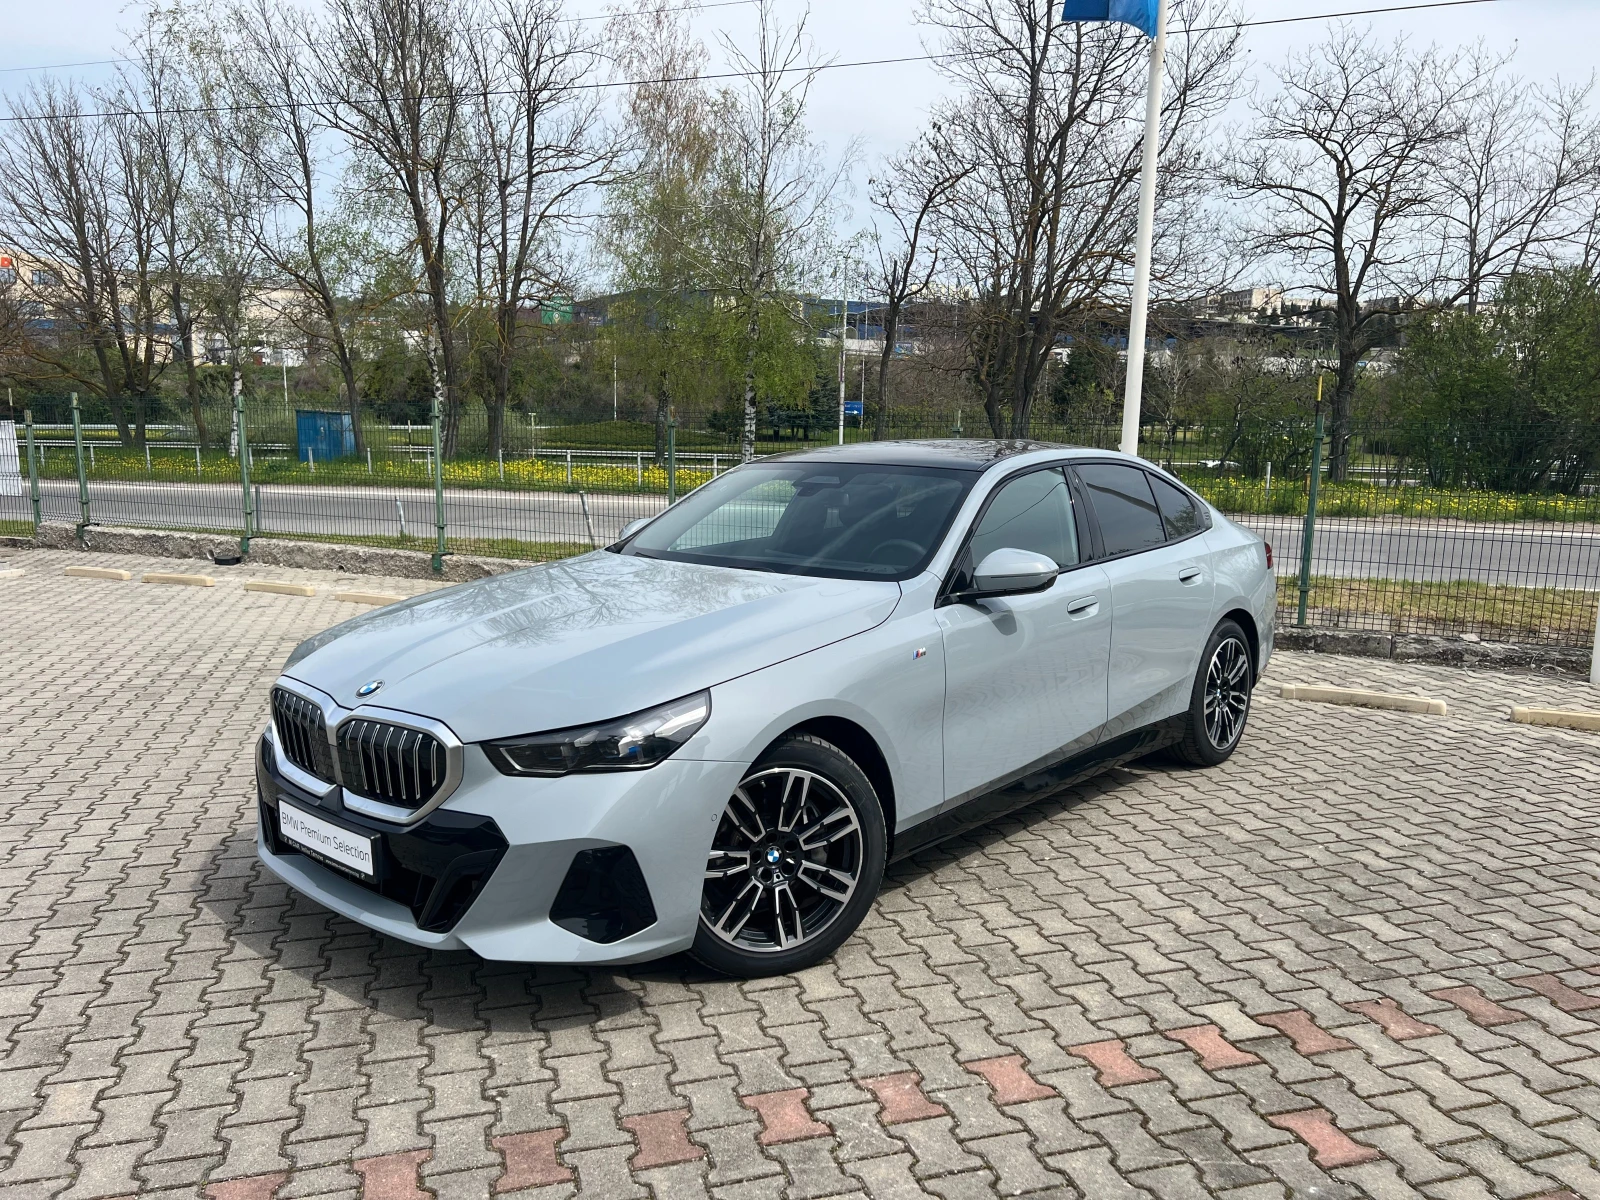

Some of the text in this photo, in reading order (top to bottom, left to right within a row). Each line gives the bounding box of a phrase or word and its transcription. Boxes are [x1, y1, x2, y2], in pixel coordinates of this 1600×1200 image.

[281, 811, 370, 863] BMW Premium Selection
